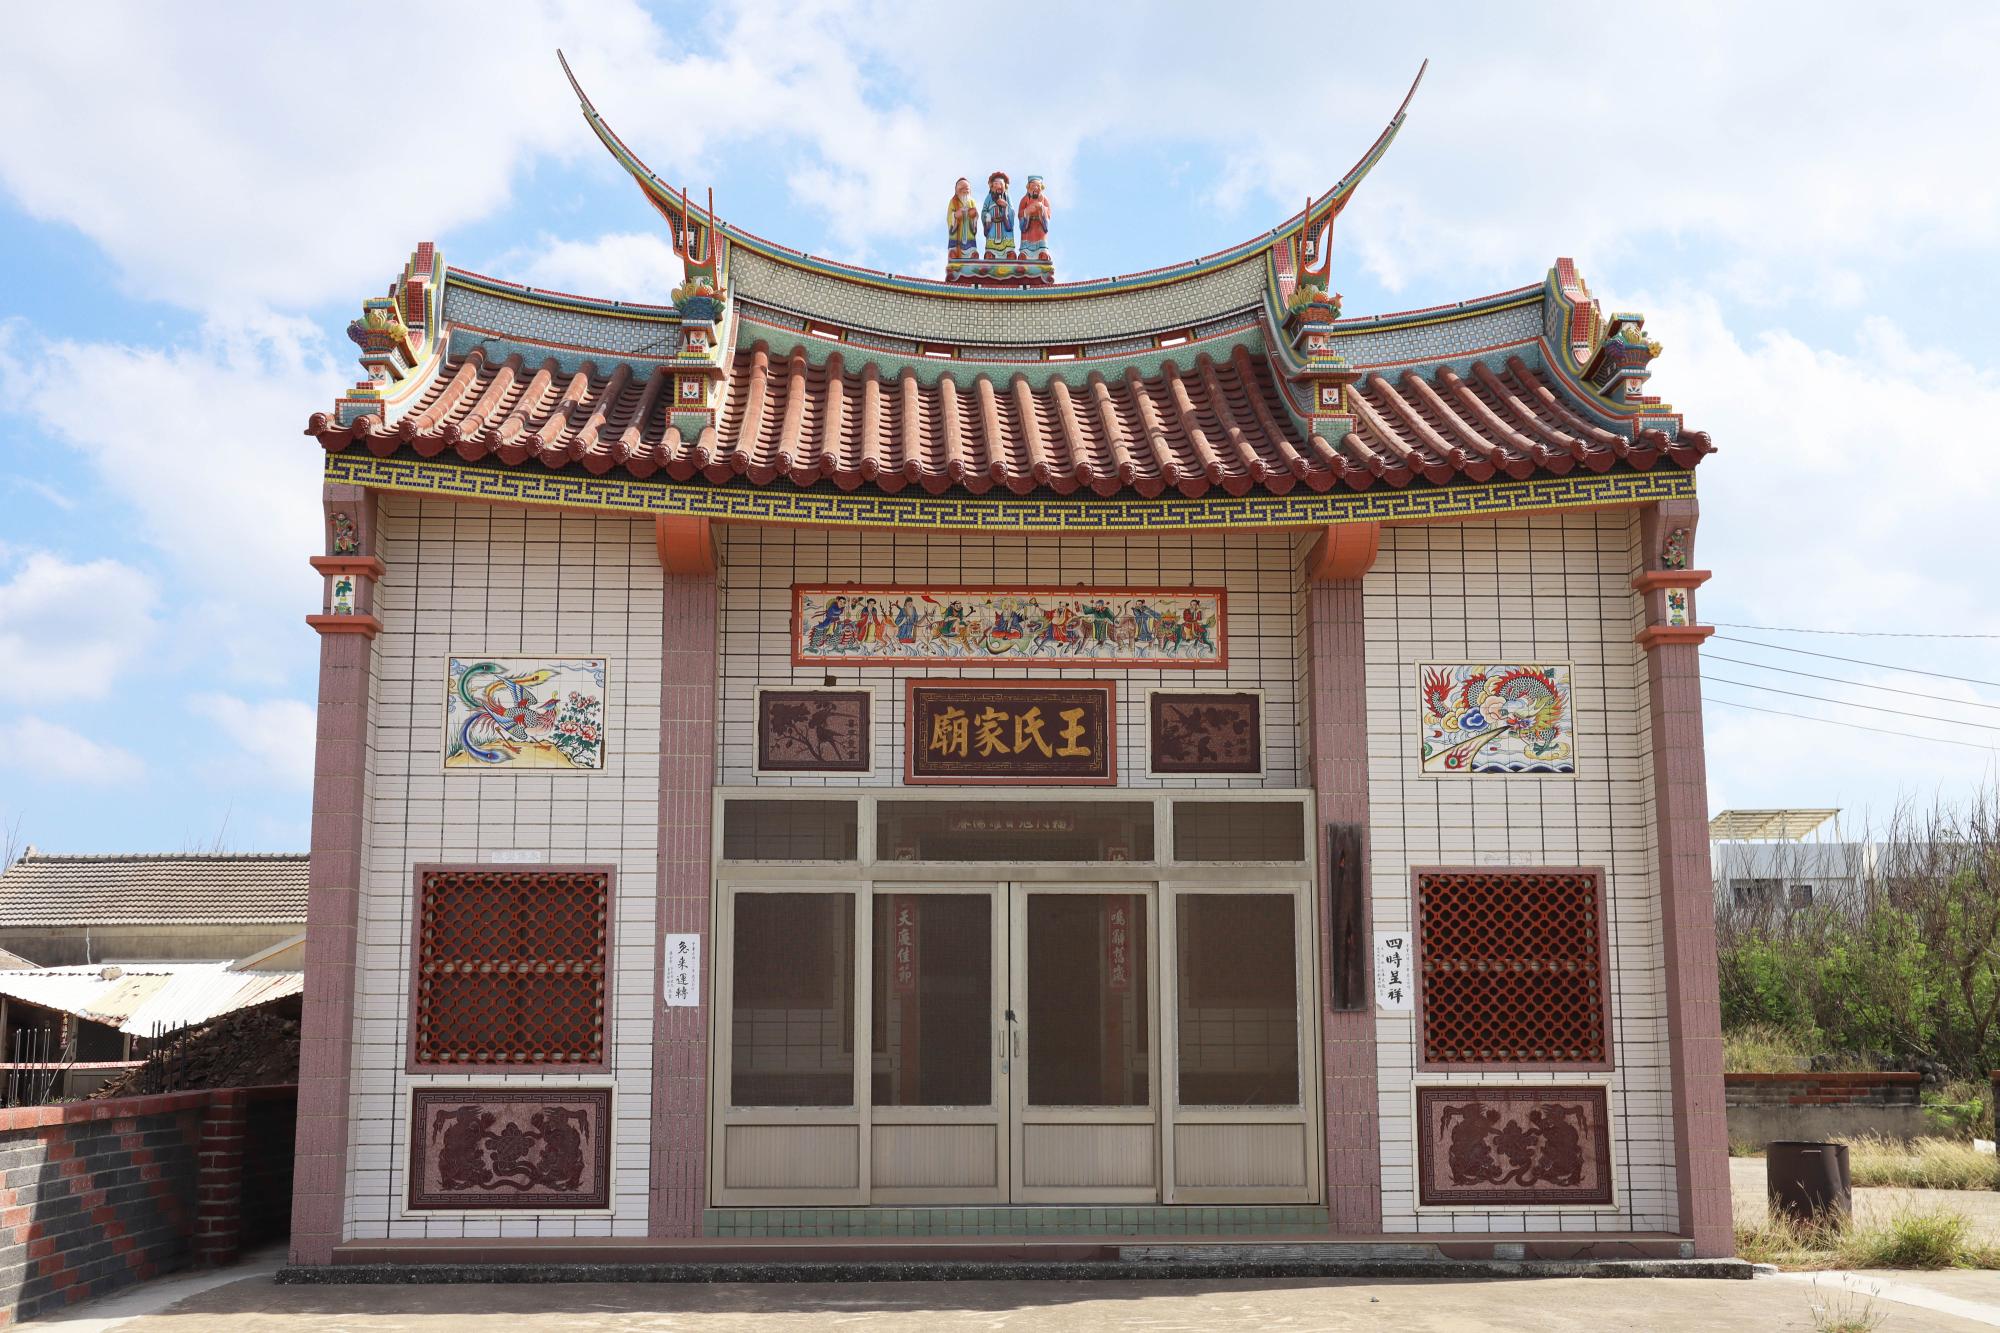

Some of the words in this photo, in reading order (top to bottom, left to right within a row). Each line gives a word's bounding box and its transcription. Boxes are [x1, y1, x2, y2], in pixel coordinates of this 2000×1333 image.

[929, 706, 1092, 758] 王氏家廟
[1385, 937, 1404, 1005] 四時呈祥
